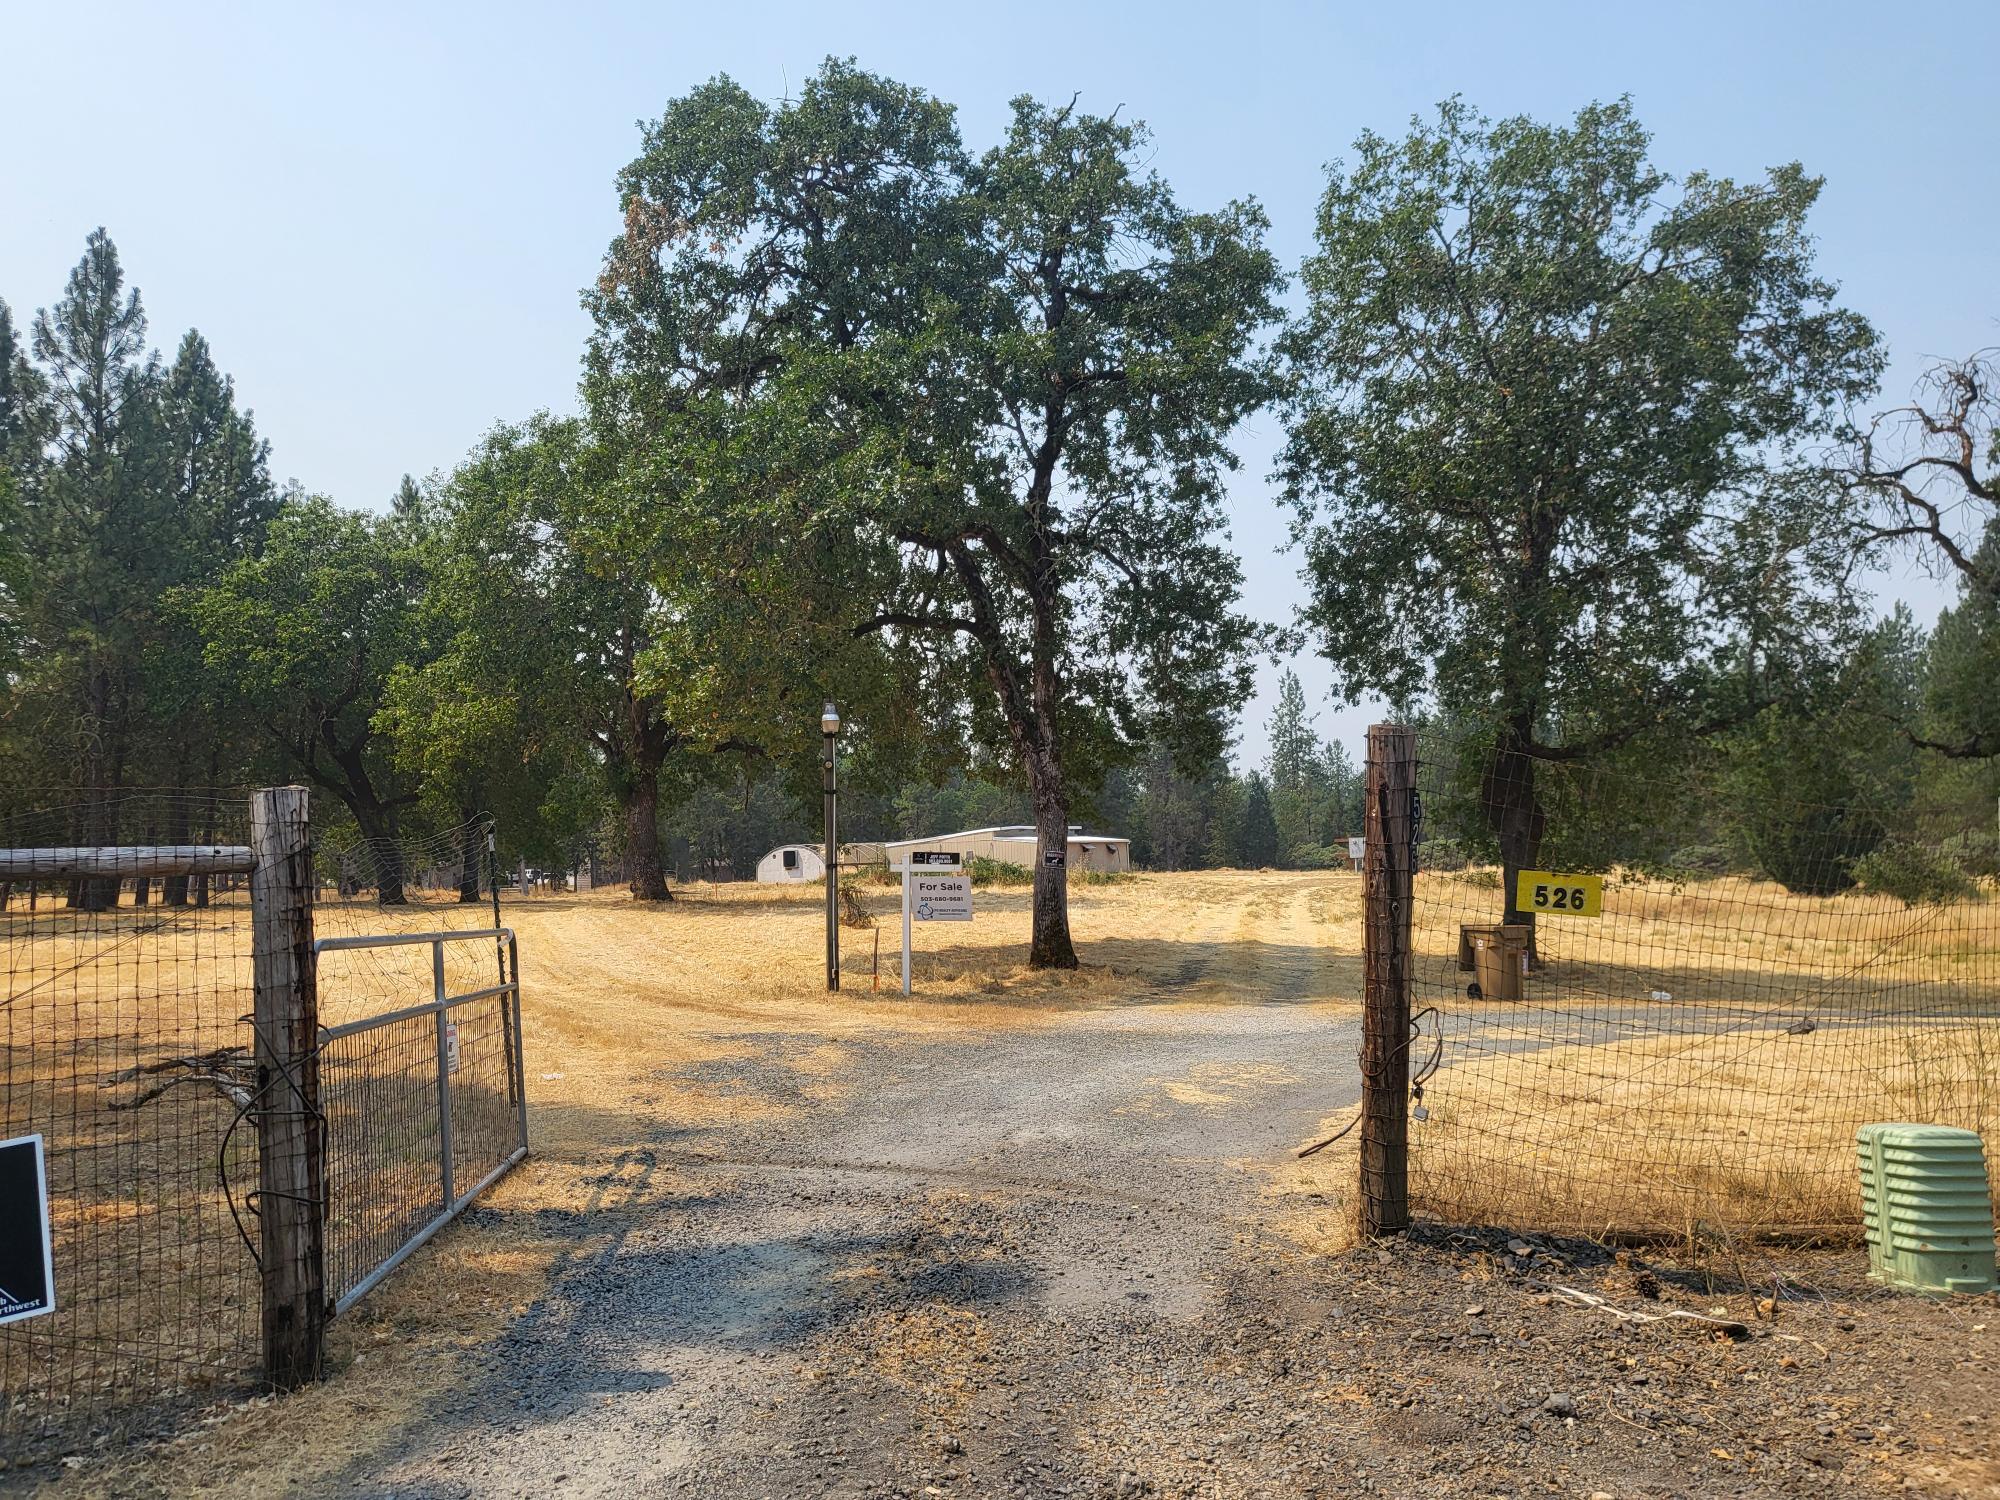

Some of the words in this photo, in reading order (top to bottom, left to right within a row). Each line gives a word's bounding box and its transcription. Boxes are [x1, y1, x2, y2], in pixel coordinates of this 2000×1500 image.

[919, 882, 938, 891] For
[940, 882, 963, 891] Sale
[1534, 885, 1585, 910] 526
